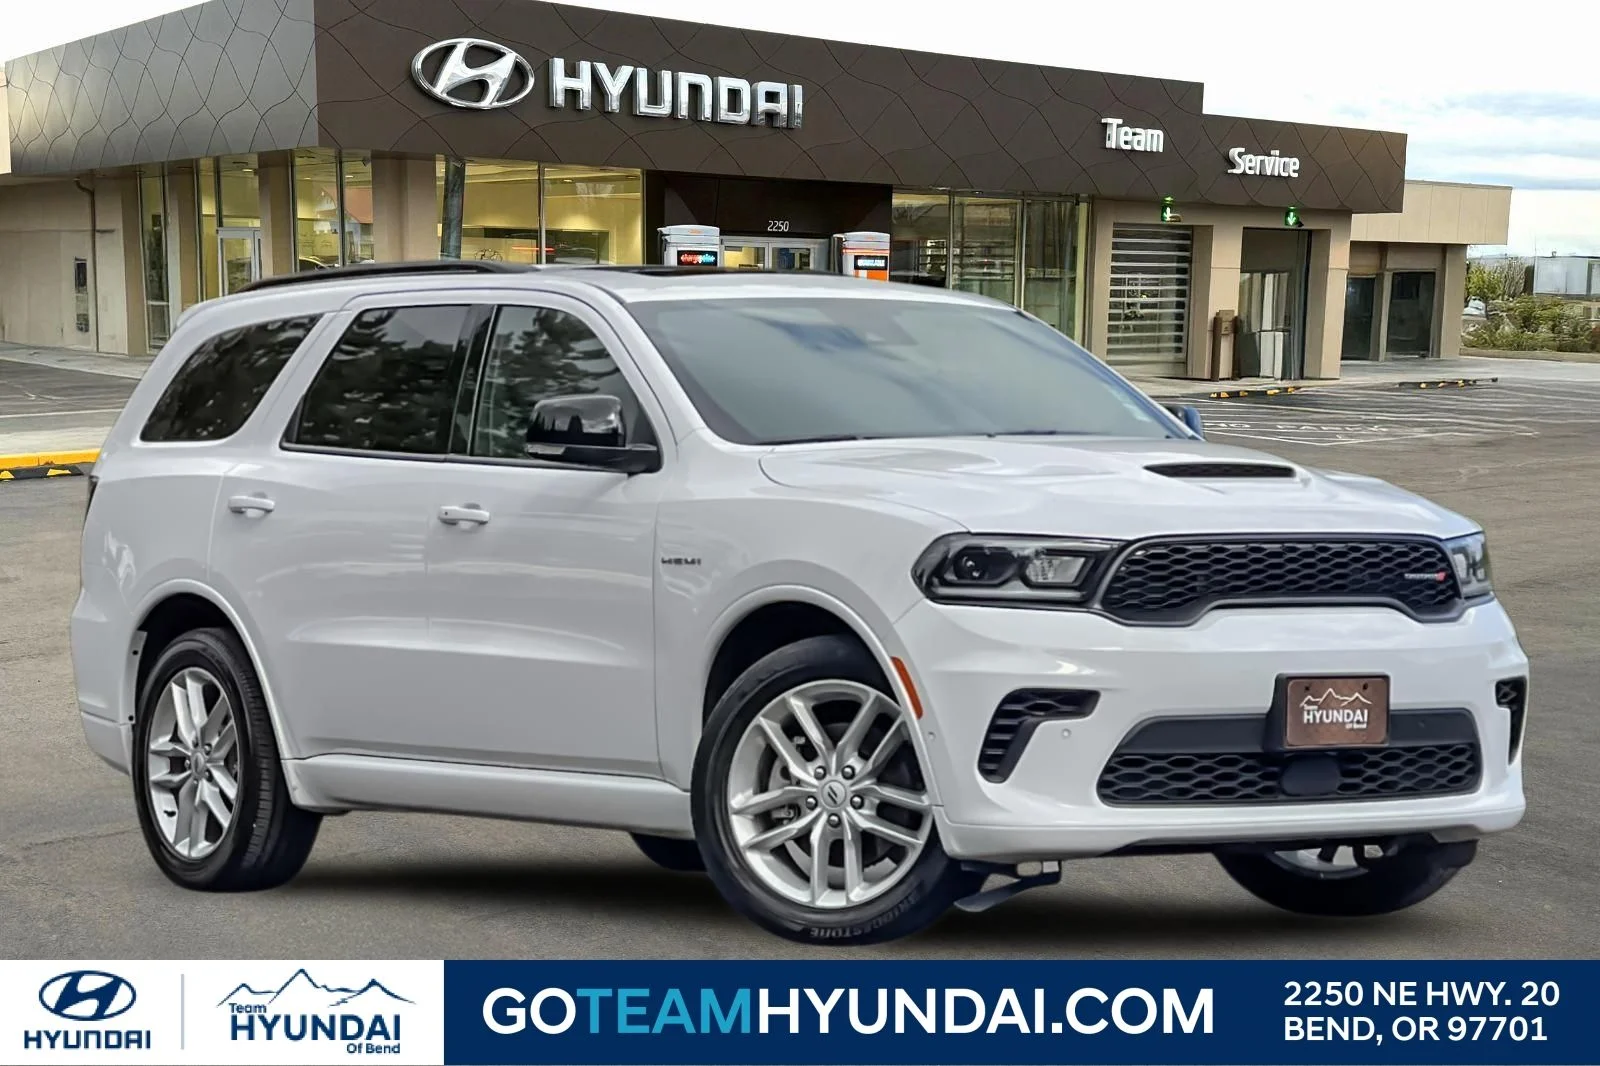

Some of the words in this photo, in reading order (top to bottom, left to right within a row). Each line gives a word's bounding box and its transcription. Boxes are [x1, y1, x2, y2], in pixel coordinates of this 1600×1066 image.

[548, 56, 803, 129] HYUNDAI
[1101, 117, 1164, 153] Team
[1227, 147, 1300, 178] Service
[767, 220, 790, 232] 2250
[1303, 709, 1368, 724] HYUNDAI
